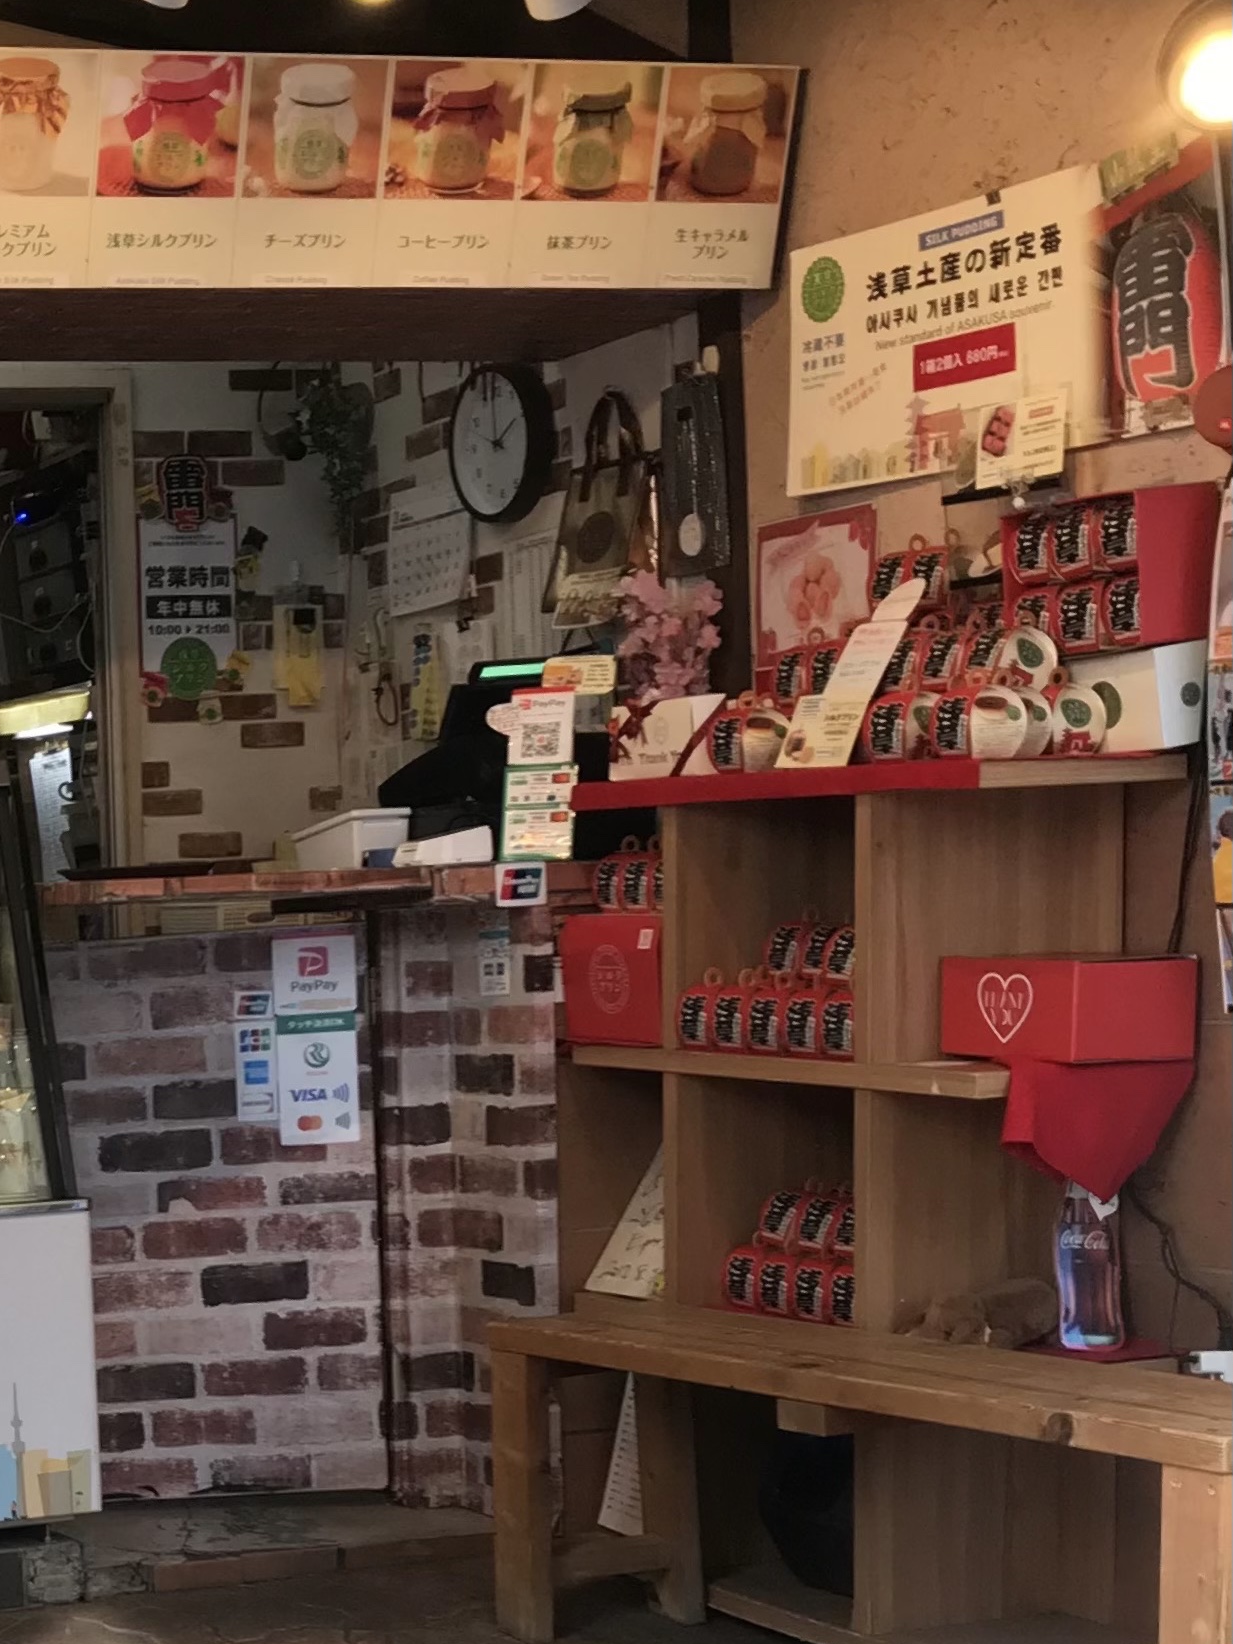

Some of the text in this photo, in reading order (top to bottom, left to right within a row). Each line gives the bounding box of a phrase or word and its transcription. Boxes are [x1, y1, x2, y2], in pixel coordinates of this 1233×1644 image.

[674, 228, 750, 245] 生キャラメル
[924, 216, 998, 247] SILK PUDDING
[106, 232, 219, 250] 浅草シルクプリン
[263, 233, 347, 250] チーズプリン
[396, 234, 491, 251] コーヒープリン
[546, 234, 613, 251] 抹茶プリン
[691, 244, 731, 261] プリン
[866, 222, 1062, 302] 浅草土産の新定番
[899, 325, 943, 345] standard
[944, 322, 955, 335] of
[957, 309, 1007, 331] ASAKUSA
[144, 565, 230, 589] 営業時間
[156, 600, 221, 617] 年中無休
[148, 624, 182, 636] 10:00
[290, 979, 339, 993] PayPay
[289, 1088, 328, 1102] VISA
